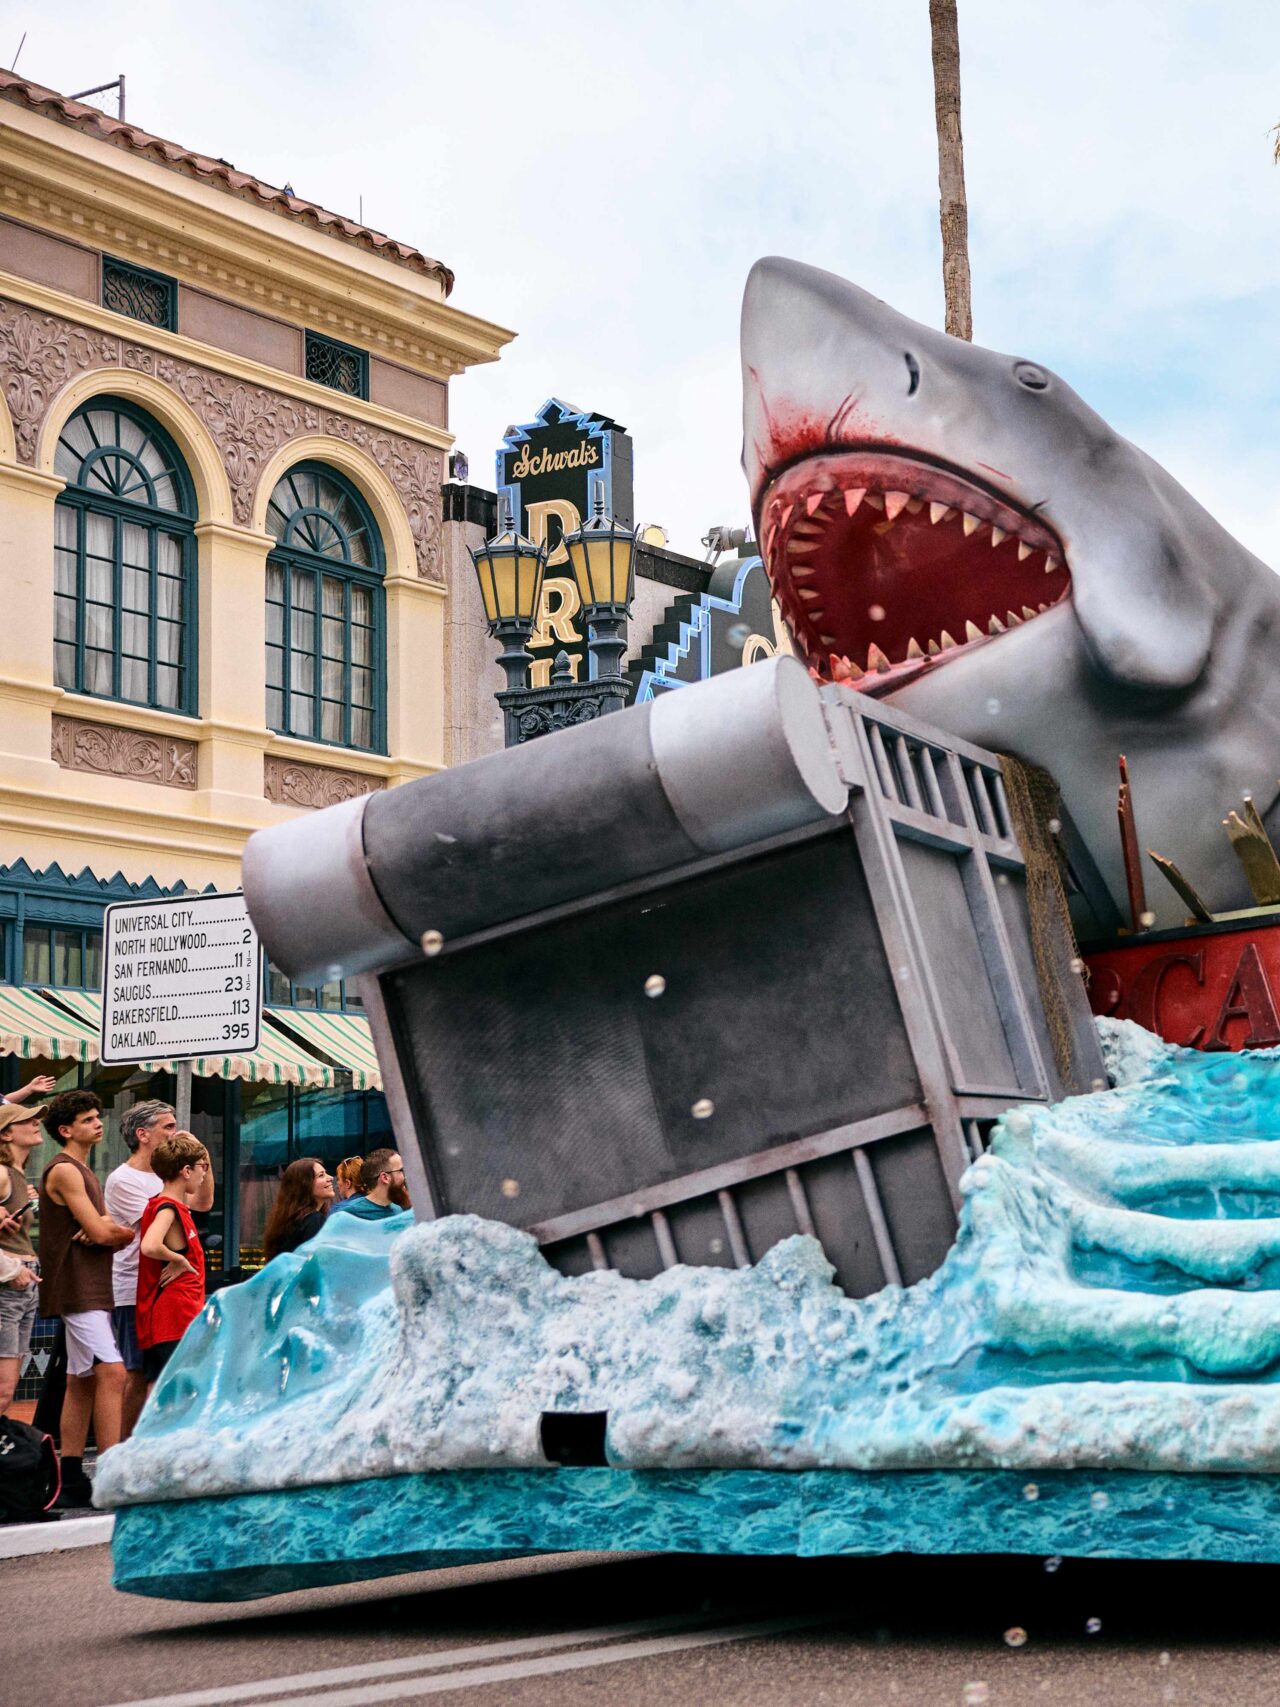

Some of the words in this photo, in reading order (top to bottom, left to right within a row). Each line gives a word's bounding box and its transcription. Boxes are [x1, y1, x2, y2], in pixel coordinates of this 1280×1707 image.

[512, 440, 599, 478] Schwab's
[115, 914, 169, 934] UNIVERSAL
[171, 911, 193, 928] CITY
[115, 939, 145, 956] NORTH
[150, 932, 207, 953] HOLLYWOOD
[242, 928, 251, 944] 2
[114, 963, 133, 980] SAN
[137, 957, 188, 977] FERNANDO
[234, 952, 243, 968] 11
[113, 984, 151, 1003] SAUGUS
[224, 976, 243, 993] 23
[112, 1005, 178, 1026] BAKERSFIELD
[232, 998, 250, 1015] 113
[111, 1030, 157, 1049] OAKLAND
[221, 1023, 250, 1040] 395
